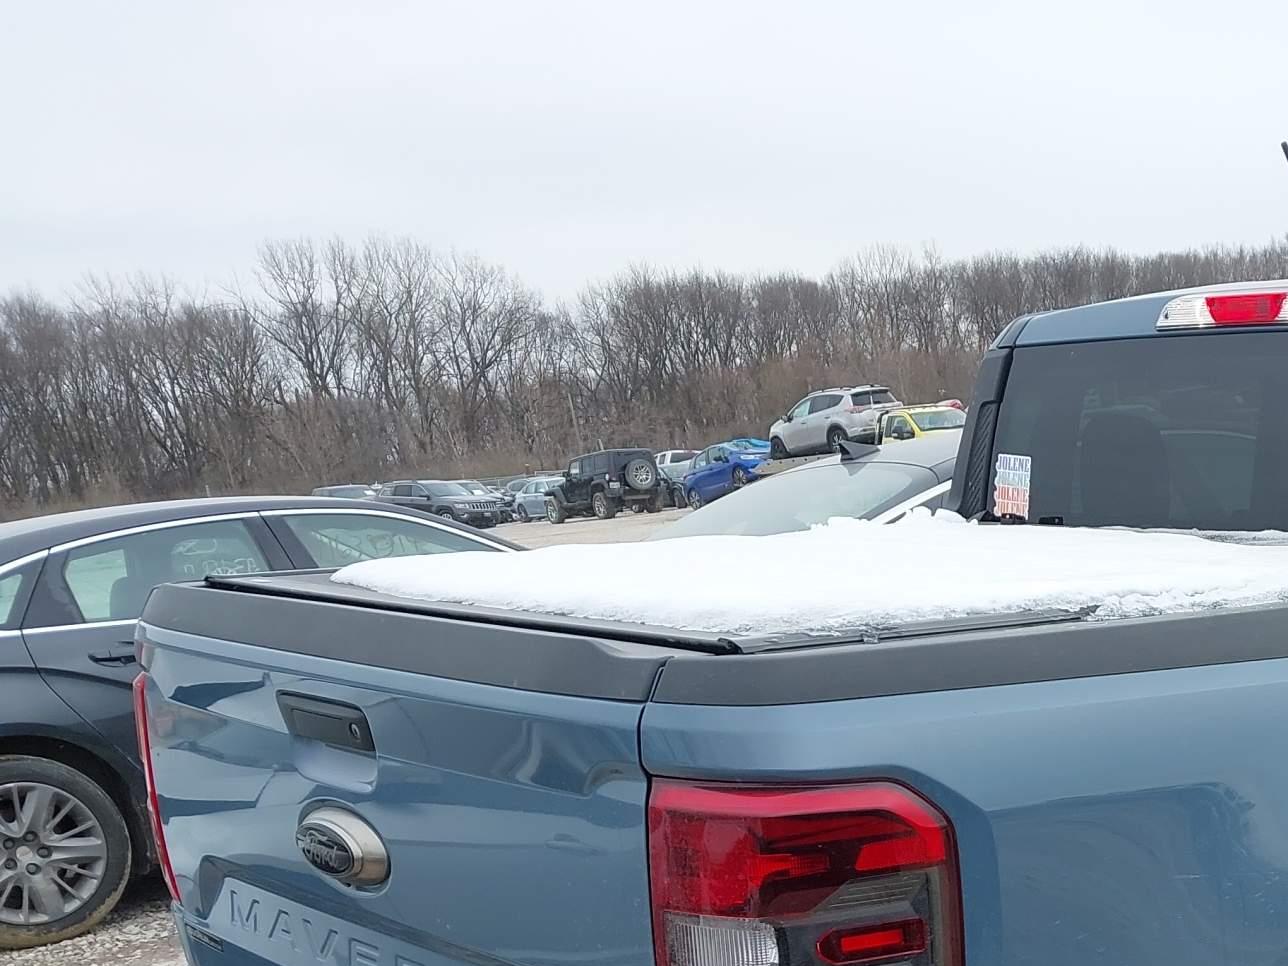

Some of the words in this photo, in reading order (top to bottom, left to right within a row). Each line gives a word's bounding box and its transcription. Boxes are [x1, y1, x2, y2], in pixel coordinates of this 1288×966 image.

[998, 456, 1030, 473] JOLENE
[996, 486, 1028, 503] JOLENE
[303, 830, 339, 868] Ford
